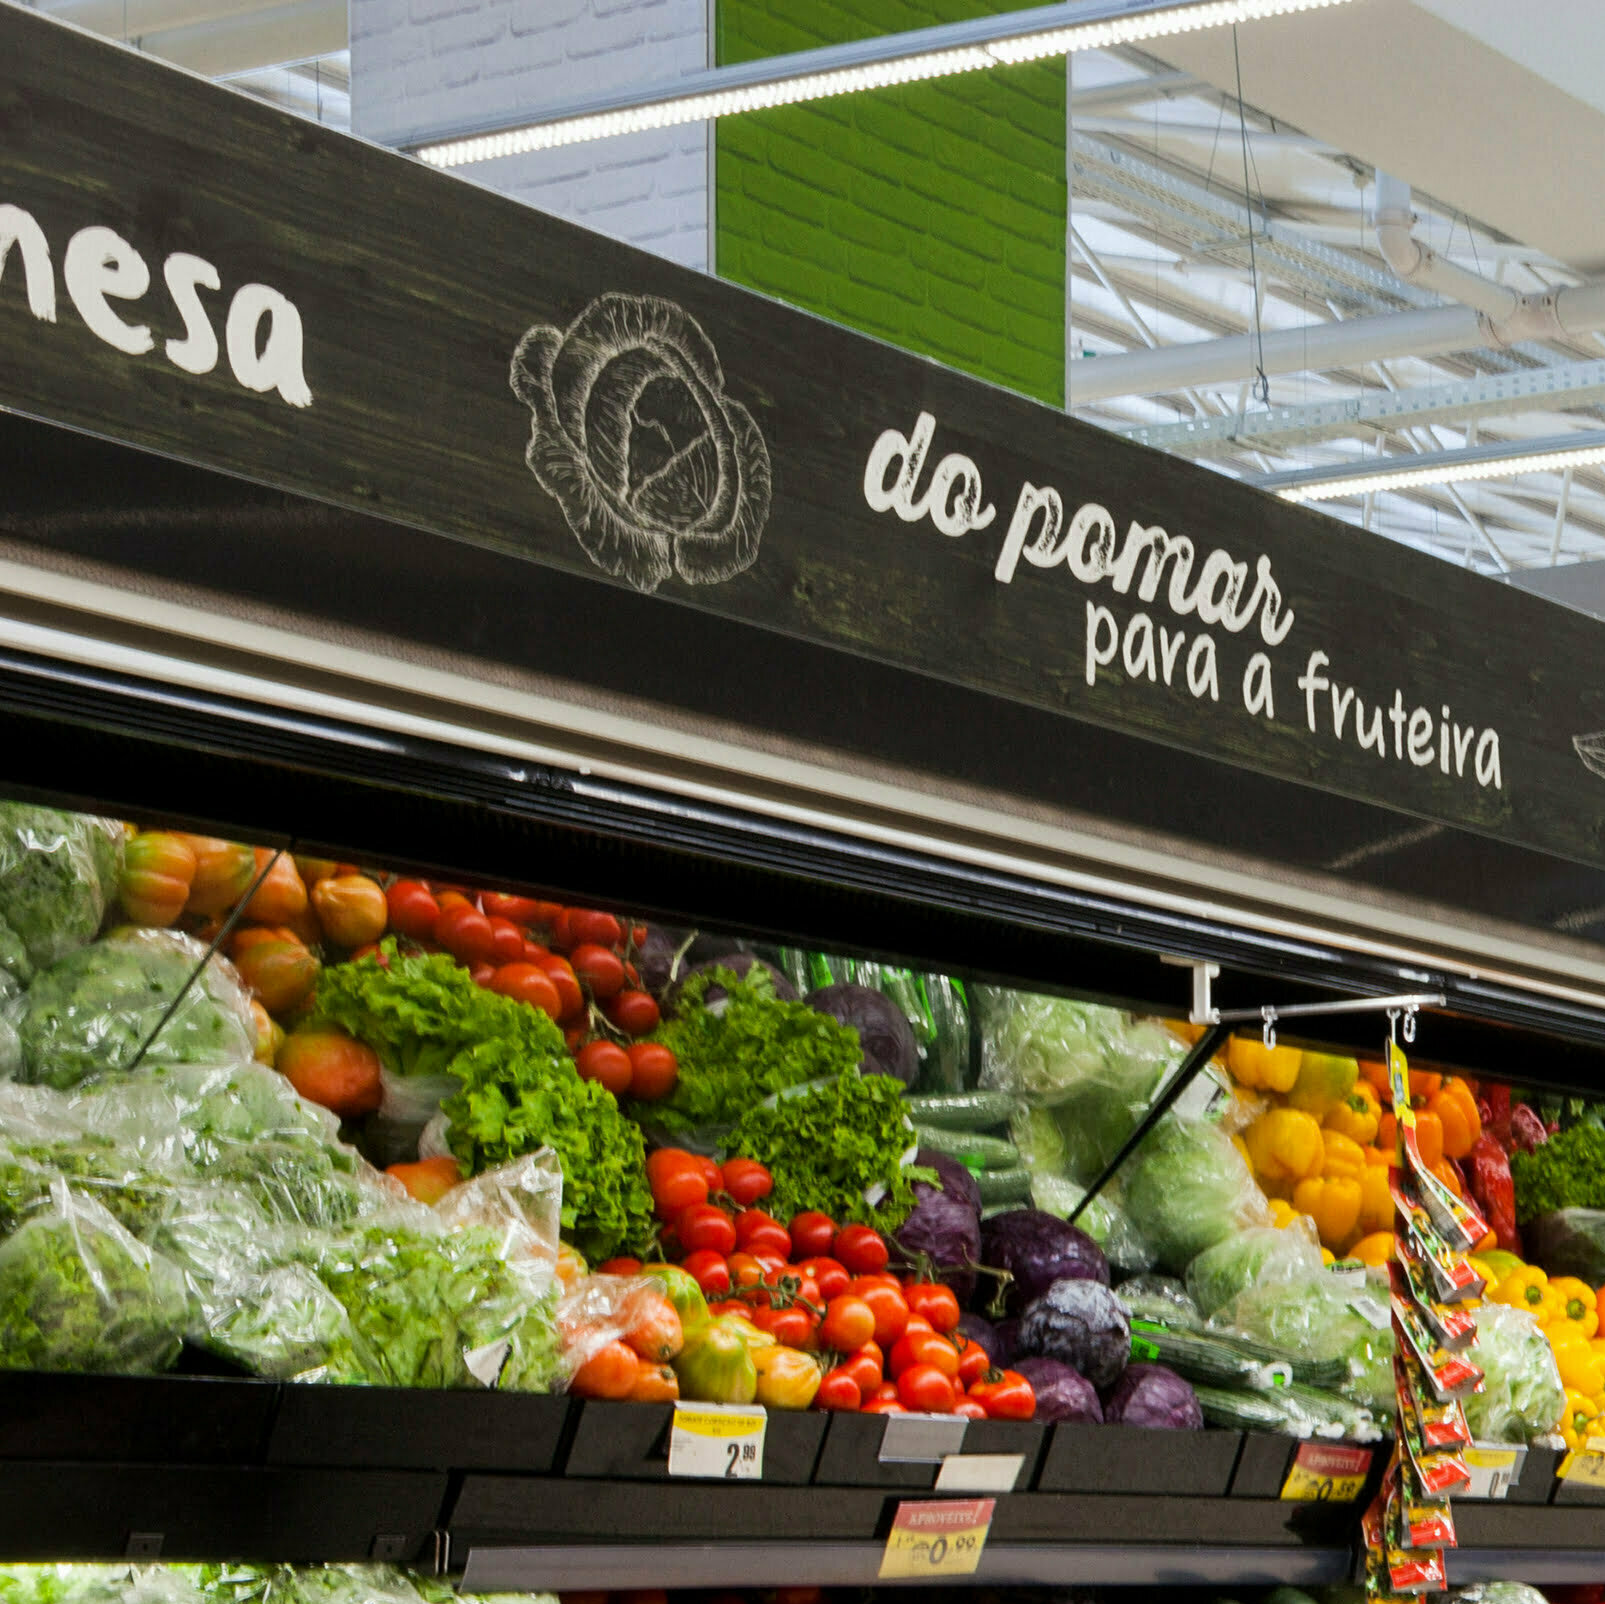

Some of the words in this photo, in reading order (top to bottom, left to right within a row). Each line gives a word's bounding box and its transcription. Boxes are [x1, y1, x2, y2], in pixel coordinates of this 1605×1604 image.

[864, 411, 995, 538] do
[995, 481, 1295, 646] pomar
[1086, 600, 1220, 701] para
[1243, 652, 1275, 720] a
[1297, 650, 1503, 790] fruteira
